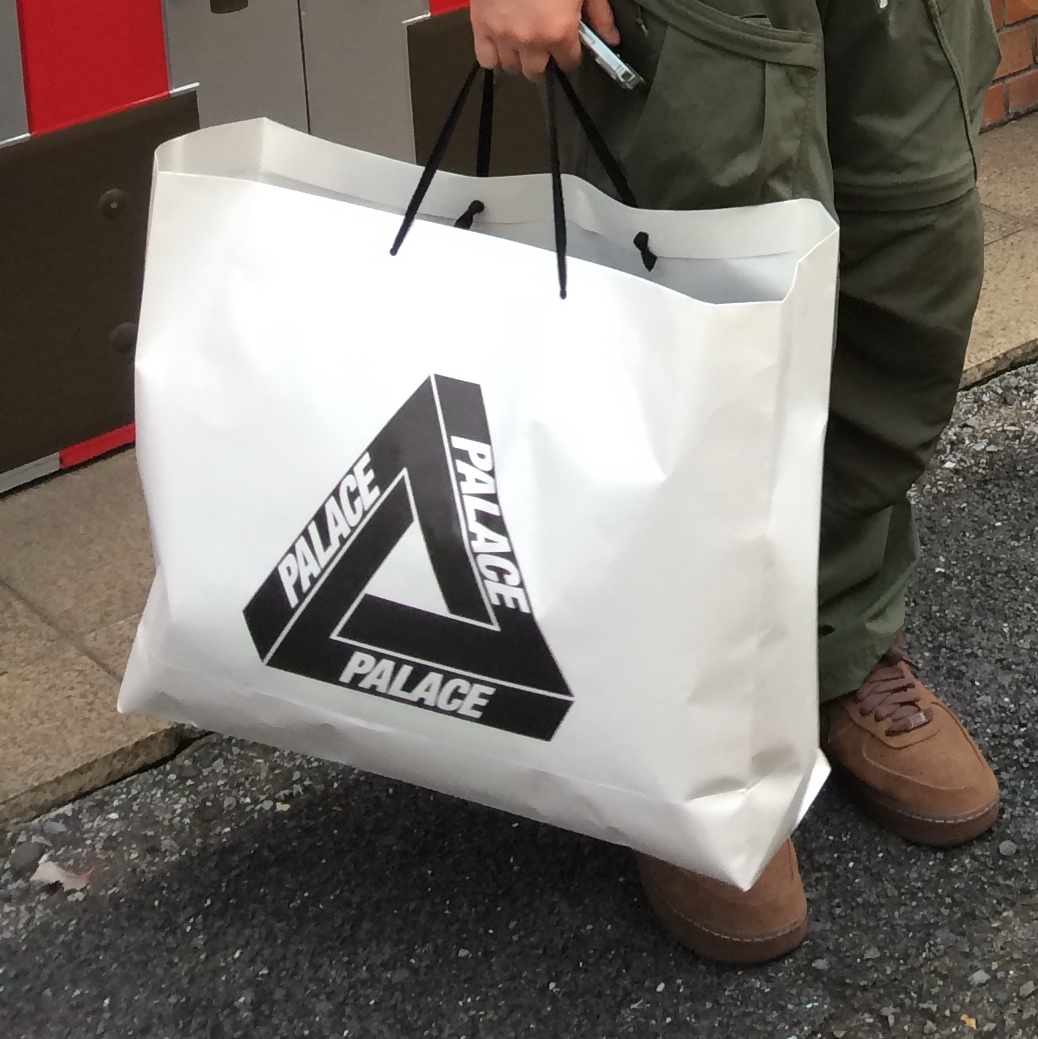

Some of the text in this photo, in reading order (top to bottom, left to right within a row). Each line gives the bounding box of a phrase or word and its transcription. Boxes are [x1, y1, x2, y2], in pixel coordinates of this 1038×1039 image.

[277, 451, 381, 609] PALACE
[450, 435, 531, 613] PALACE
[338, 650, 497, 719] PALACE
